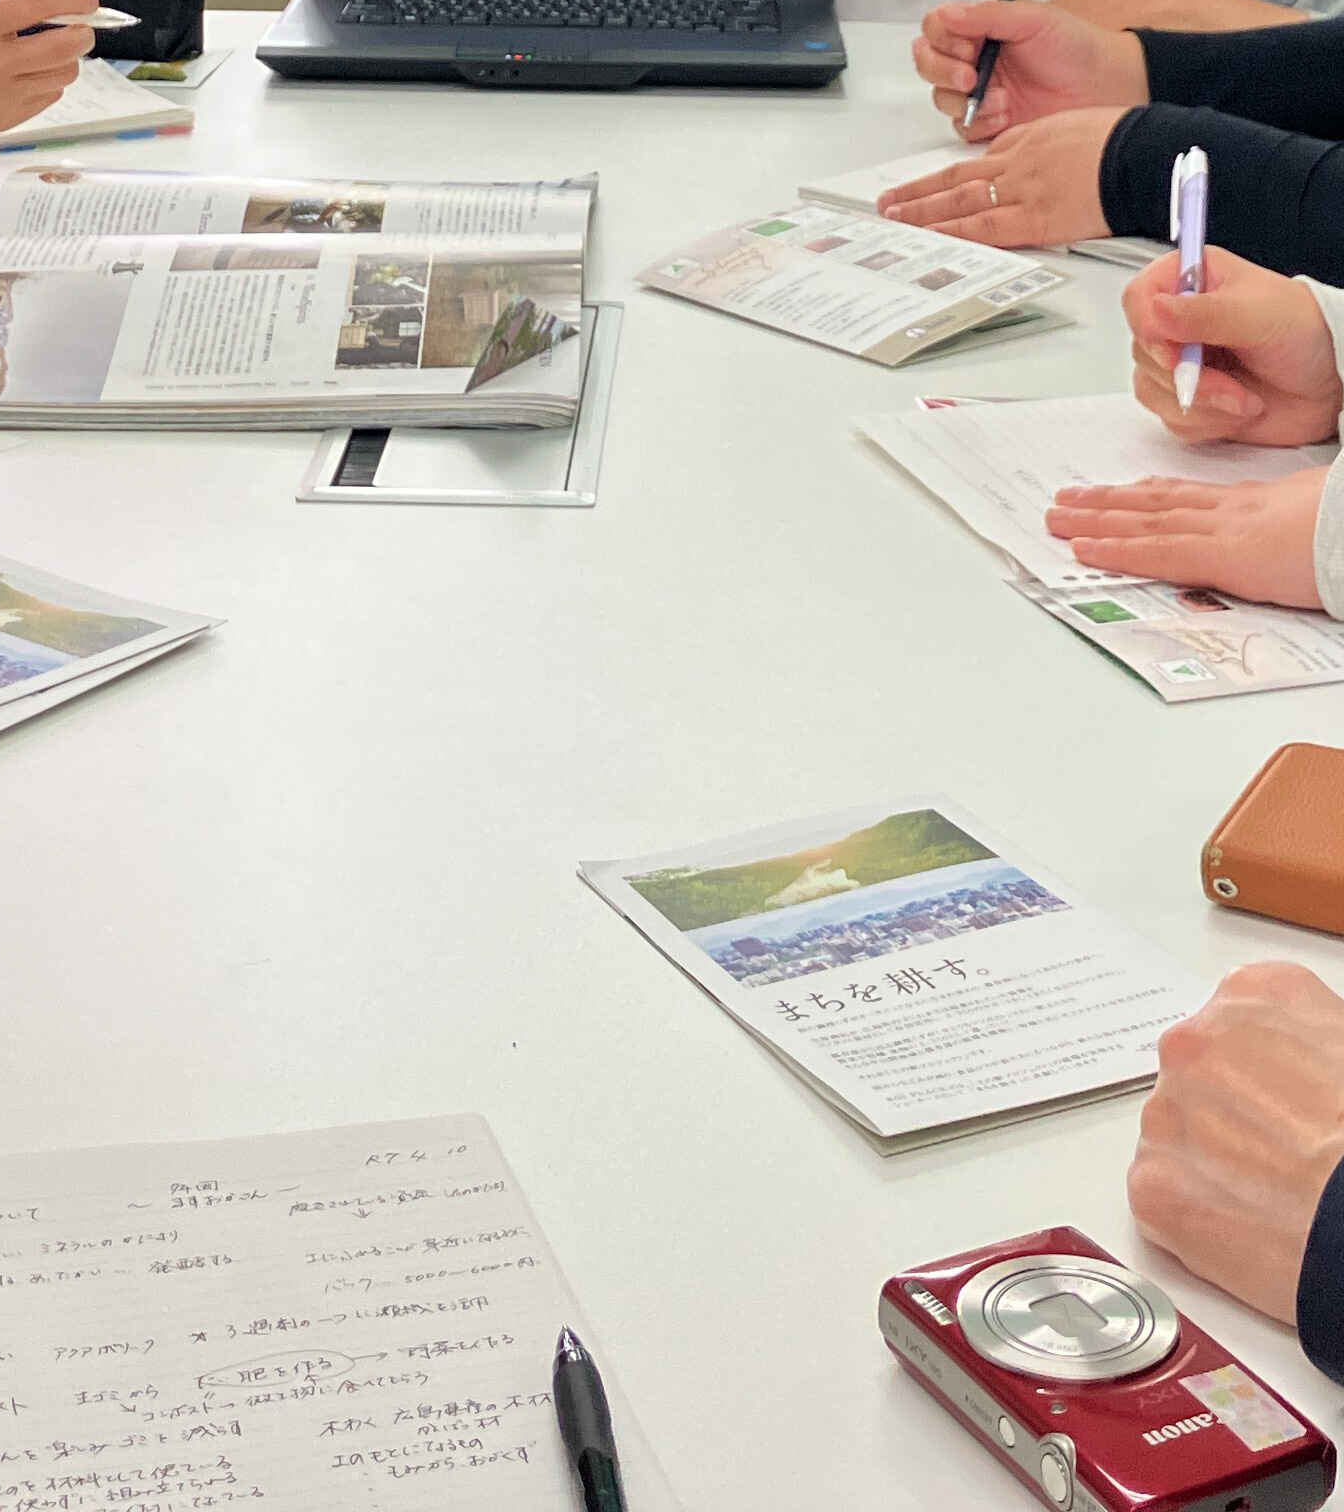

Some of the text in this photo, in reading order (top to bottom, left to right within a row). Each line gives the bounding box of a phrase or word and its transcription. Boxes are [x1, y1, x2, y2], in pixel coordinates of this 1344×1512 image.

[775, 956, 991, 1023] まちを耕す。
[1142, 1411, 1227, 1447] anon
